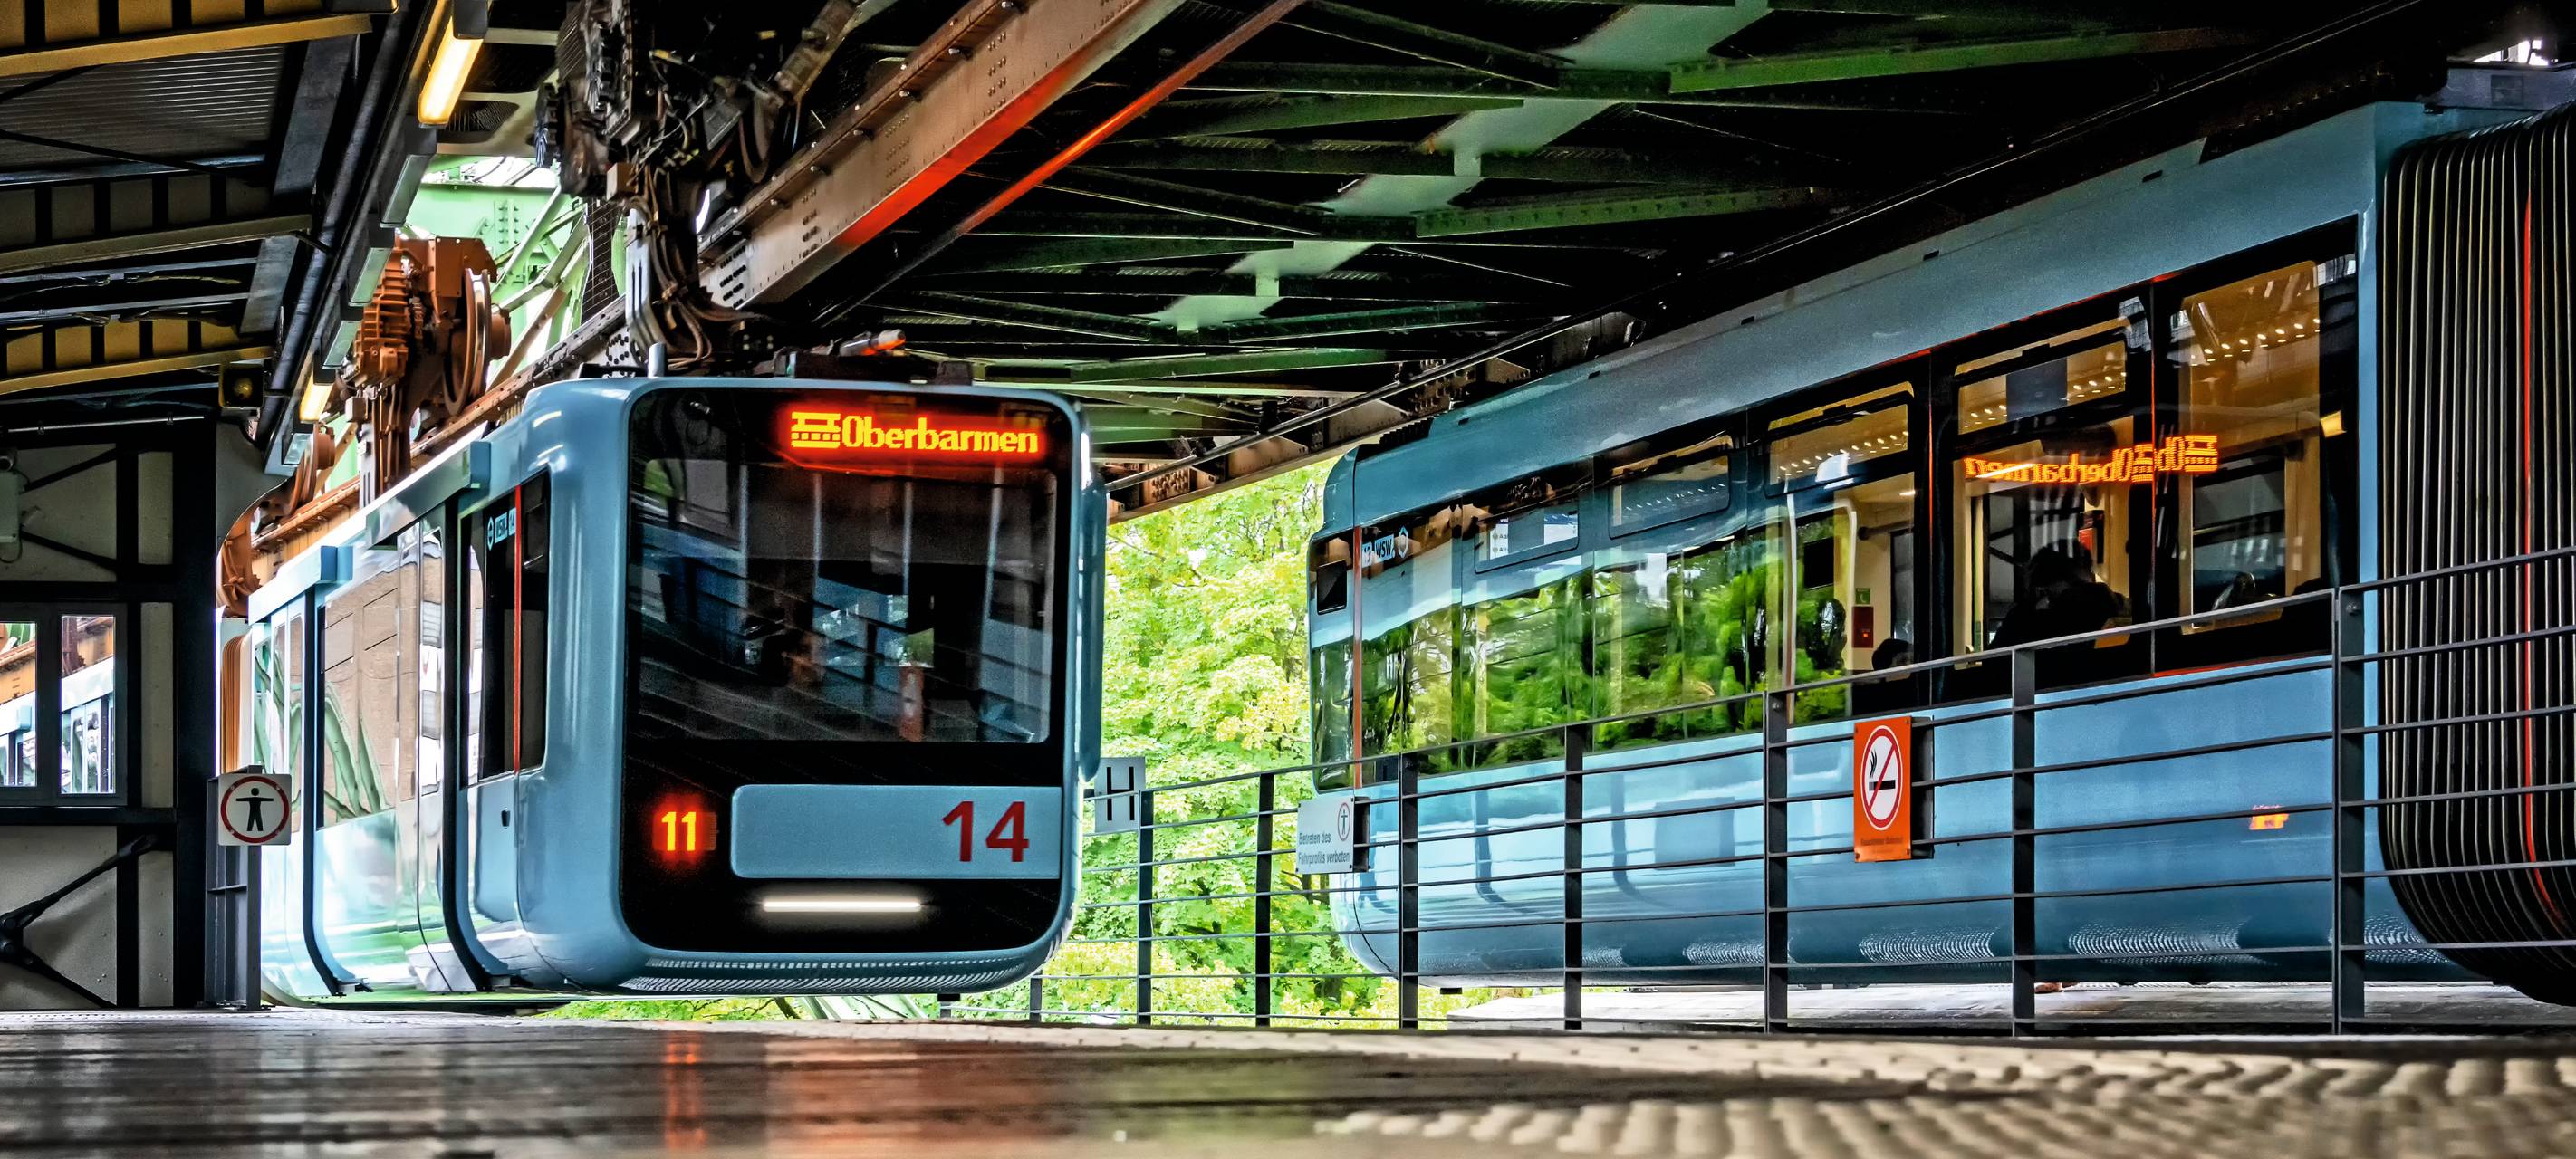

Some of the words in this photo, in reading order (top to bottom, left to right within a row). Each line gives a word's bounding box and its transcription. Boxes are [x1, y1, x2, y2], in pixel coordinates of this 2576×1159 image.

[841, 415, 1039, 454] Oberbarmen
[1375, 538, 1393, 559] WSW
[1106, 766, 1135, 821] H
[661, 810, 697, 851] 11
[941, 800, 1030, 863] 14
[1298, 832, 1321, 845] Betreten
[1322, 831, 1331, 843] des
[1326, 850, 1350, 863] verboten
